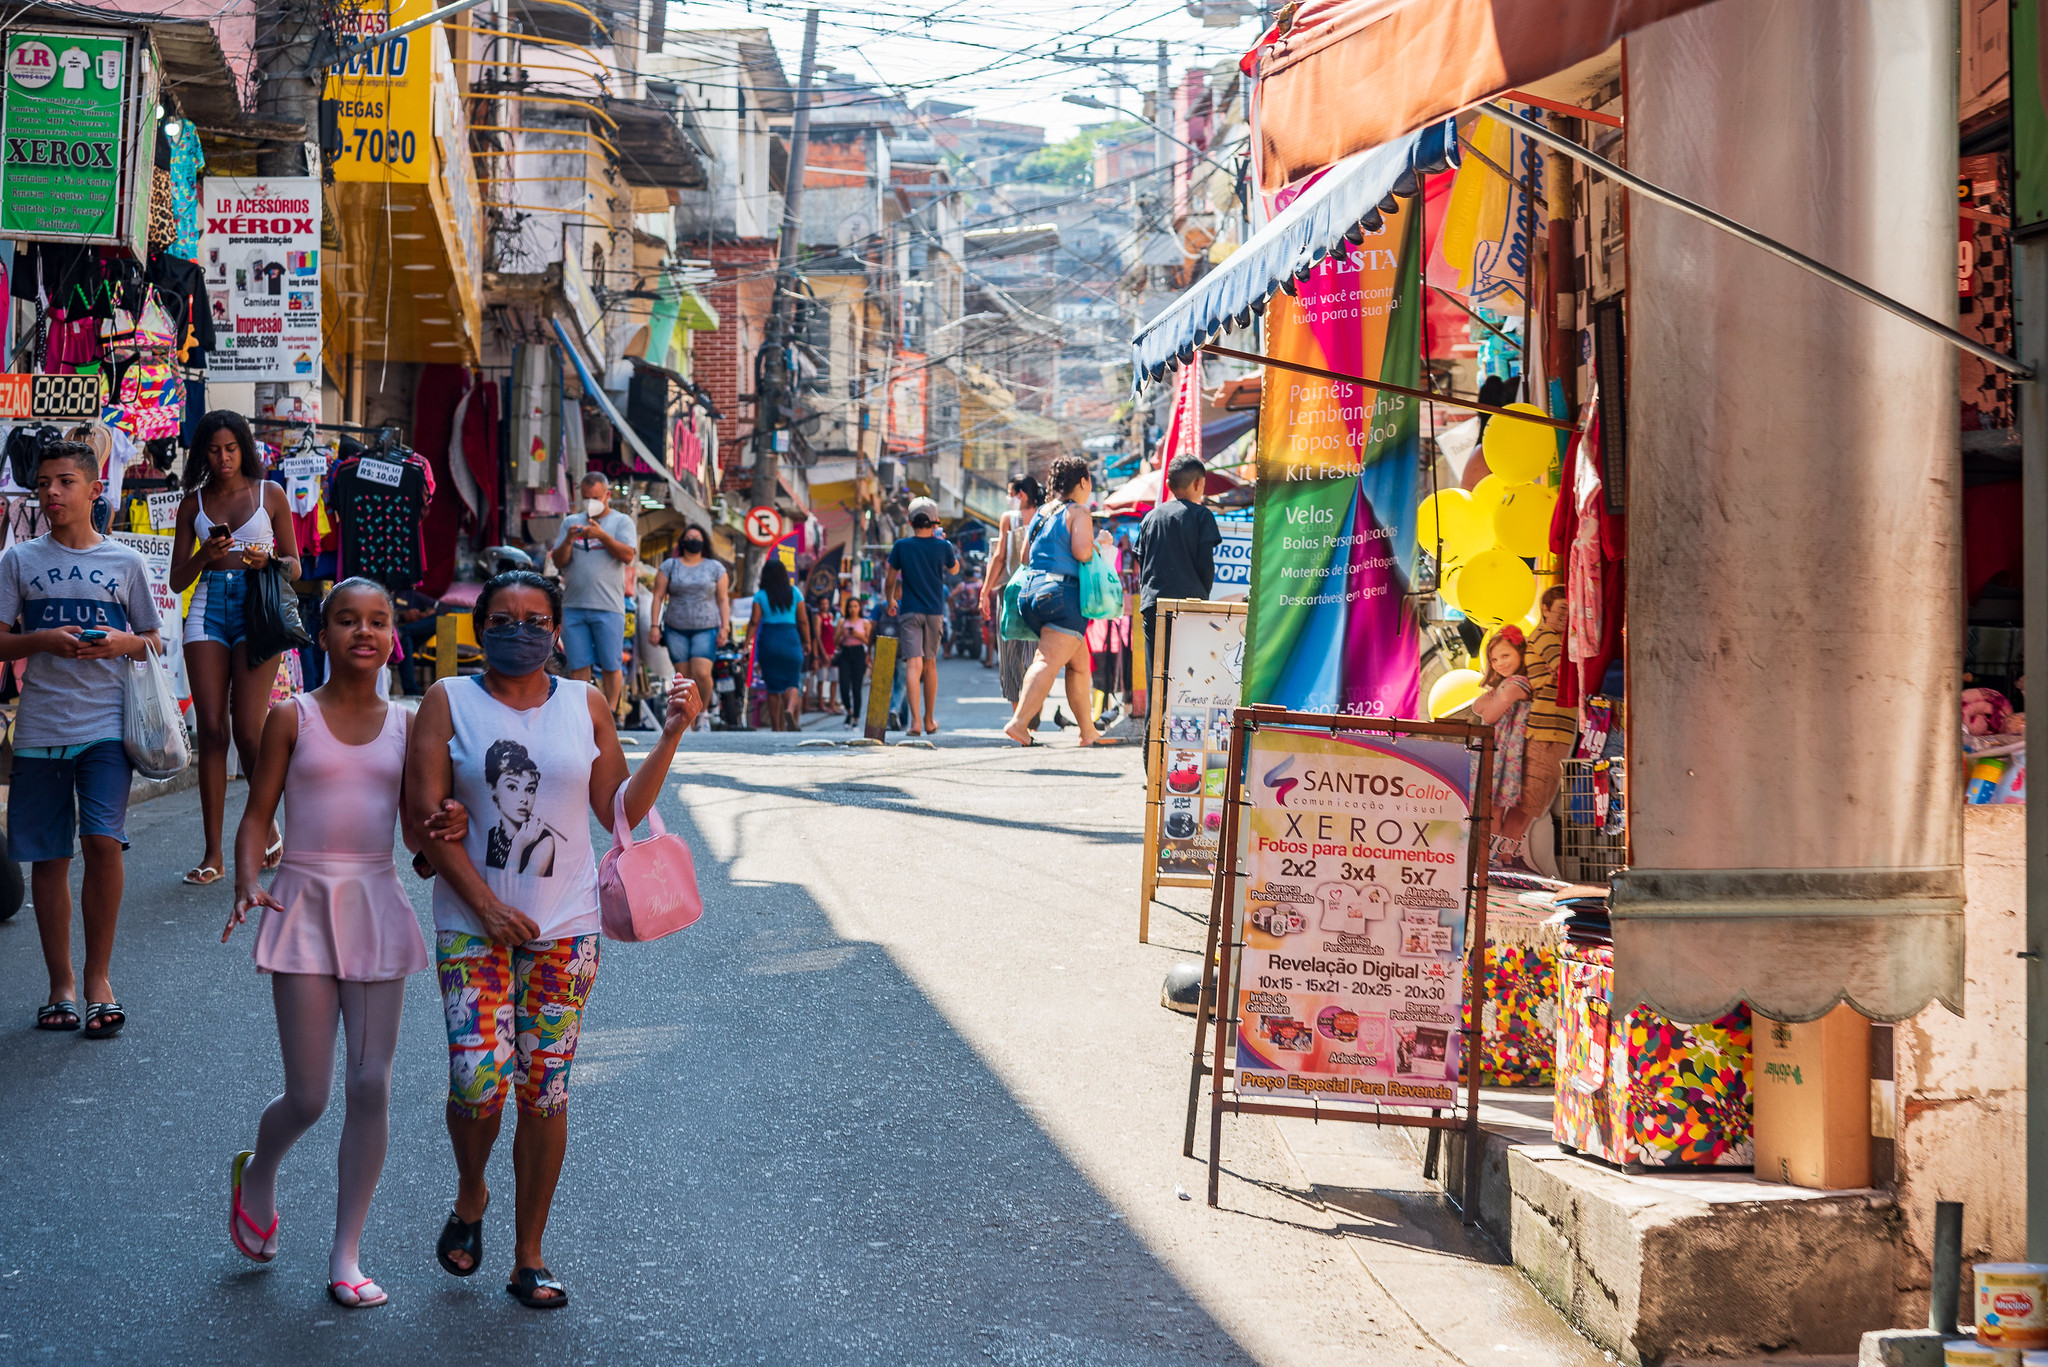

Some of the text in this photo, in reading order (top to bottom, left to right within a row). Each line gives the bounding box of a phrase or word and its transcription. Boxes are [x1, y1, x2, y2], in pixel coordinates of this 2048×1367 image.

[16, 48, 51, 67] LR
[8, 105, 114, 118] Camisas Canecas Chinelos
[337, 101, 383, 118] REGAS
[16, 116, 41, 124] Pratos
[70, 119, 103, 128] Squeezes
[33, 128, 70, 136] materiais
[86, 130, 118, 138] consulta
[6, 138, 113, 168] XEROX
[7, 173, 49, 184] Curriculum
[63, 176, 75, 185] Via
[76, 178, 85, 186] de
[86, 177, 111, 187] Contas
[12, 188, 108, 201] Renavam Pesquisas Duda
[10, 202, 105, 218] Contratos Ipva Recargas
[217, 195, 310, 214] LR ACESSÓRIOS
[36, 218, 81, 230] Plastificação
[206, 214, 314, 234] XÉROX
[228, 236, 293, 246] personalização
[1319, 249, 1398, 276] FESTA
[243, 297, 280, 307] Camisetas
[1292, 286, 1394, 307] Aqui você encontr
[1292, 310, 1318, 325] tudo
[1321, 307, 1347, 324] para
[1350, 307, 1358, 318] a
[1361, 304, 1383, 317] sua
[236, 312, 283, 337] Impressão
[236, 335, 278, 348] 99905-6290
[1290, 380, 1354, 403] Painéis
[1288, 434, 1340, 455] Topos
[1346, 428, 1366, 447] de
[360, 467, 399, 483] R$: 10,00
[1286, 461, 1367, 482] Kit Festas
[1285, 505, 1334, 524] Velas
[759, 515, 769, 536] E
[1283, 536, 1319, 550] Bolas
[1332, 564, 1343, 576] de
[30, 565, 119, 596] TRACK
[1279, 592, 1343, 606] Descartáveis
[1345, 590, 1360, 602] em
[42, 605, 108, 623] CLUB
[1293, 797, 1444, 814] comunicação visual
[1285, 813, 1430, 848] XEROX
[1258, 837, 1455, 865] Fotos para documentos
[1280, 858, 1437, 886] 2x2 3x4 5x7
[1265, 881, 1301, 894] Caneca
[1405, 886, 1449, 899] Almofada
[1251, 890, 1315, 904] Personalizada
[1394, 894, 1458, 910] Personalizada
[1337, 934, 1371, 946] Camisa
[1323, 941, 1385, 956] Personalizada
[1268, 954, 1419, 982] Revelação Digital
[1258, 976, 1446, 1000] 10x15 15x21 20x25 20x30
[1250, 992, 1287, 1004] Imãs de
[1246, 1002, 1290, 1015] Geladeira
[1405, 1002, 1440, 1014] Banner
[1390, 1009, 1455, 1024] Personalizado
[1328, 1052, 1377, 1066] Adesivos
[1241, 1072, 1452, 1100] Preço Especial Para Revenda
